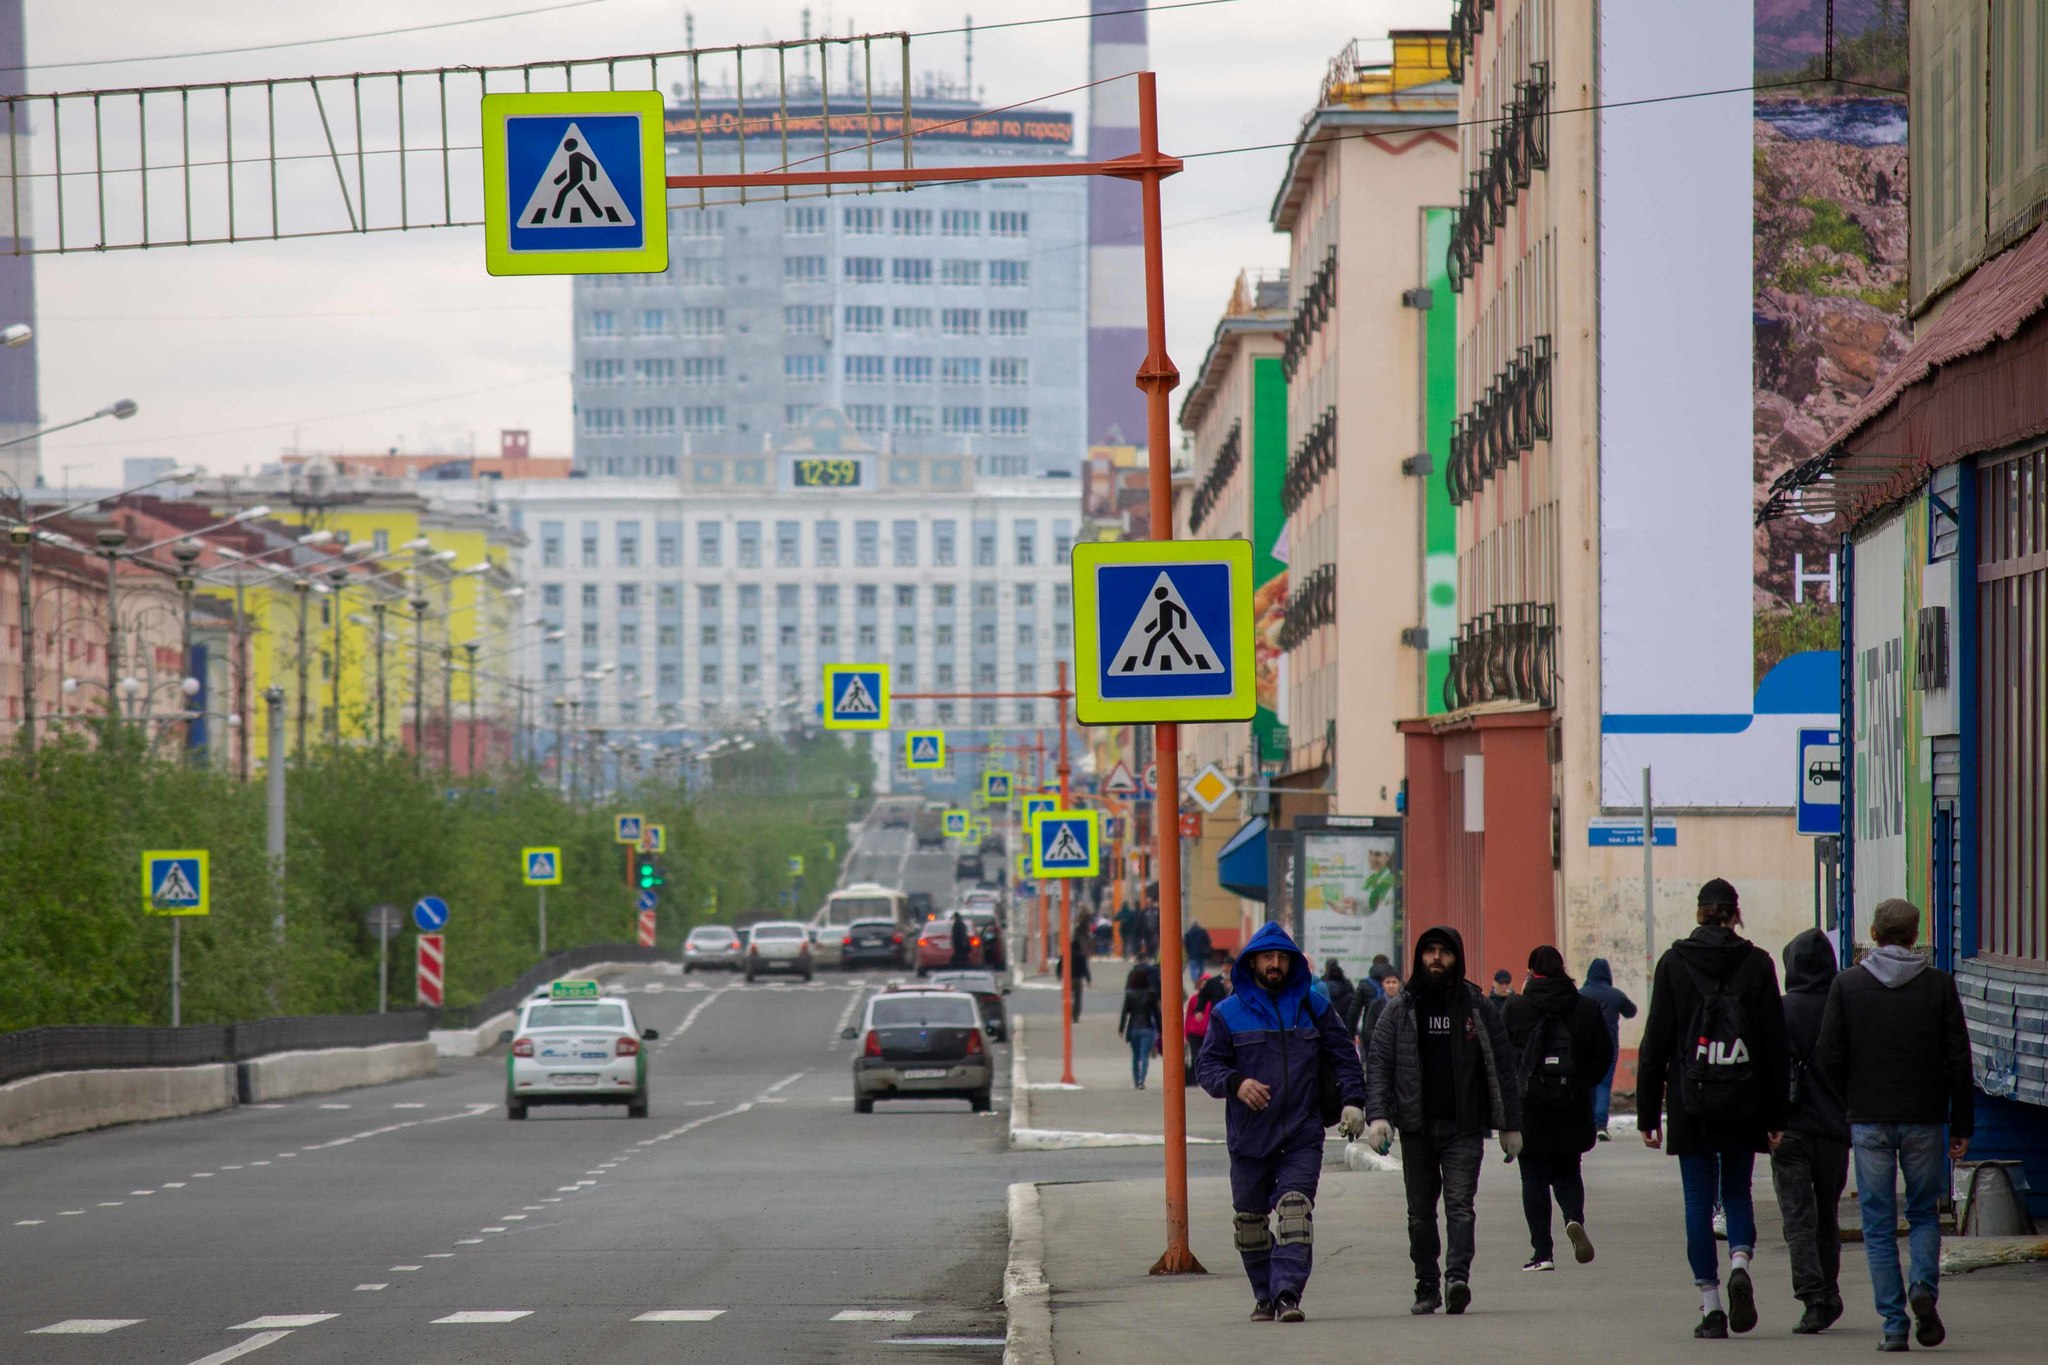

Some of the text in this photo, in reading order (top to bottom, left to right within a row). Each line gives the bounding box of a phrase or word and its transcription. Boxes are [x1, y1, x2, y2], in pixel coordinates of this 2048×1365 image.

[1002, 120, 1021, 137] по
[1023, 121, 1073, 143] городу
[1696, 1036, 1750, 1065] FILA
